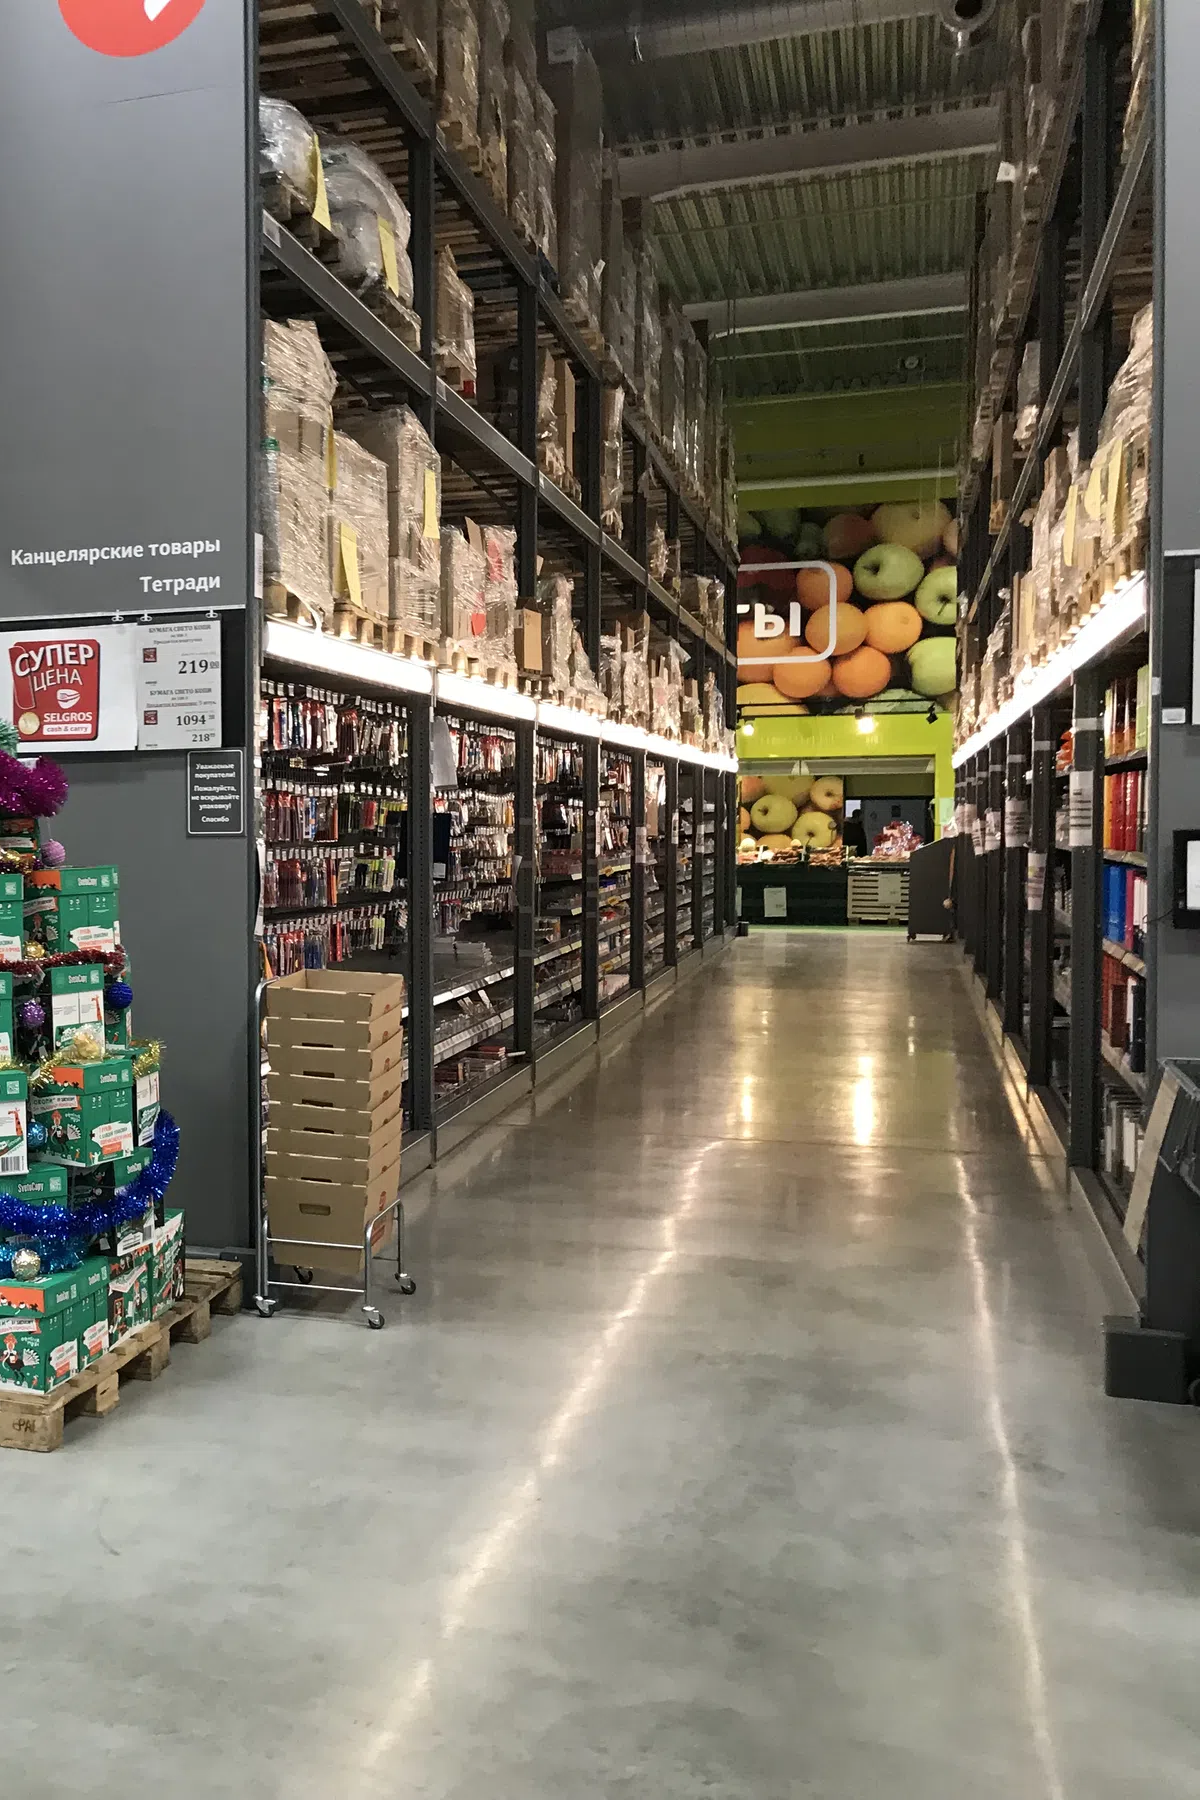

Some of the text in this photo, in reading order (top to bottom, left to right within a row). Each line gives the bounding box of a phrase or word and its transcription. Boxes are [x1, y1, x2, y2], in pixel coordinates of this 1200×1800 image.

[11, 539, 221, 566] Канцелярские товары
[139, 575, 221, 595] Тетради
[15, 643, 94, 677] СУПЕР
[178, 660, 208, 674] 219
[32, 667, 83, 692] ЦЕНА
[43, 712, 92, 723] SELGROS
[176, 715, 206, 726] 1094
[191, 734, 210, 742] 218
[195, 763, 234, 771] Уважаемые
[194, 771, 236, 779] покупатели!
[193, 784, 237, 792] Пожалуйста,
[201, 793, 239, 802] вскрывайте
[17, 1181, 44, 1193] SvetoCopy
